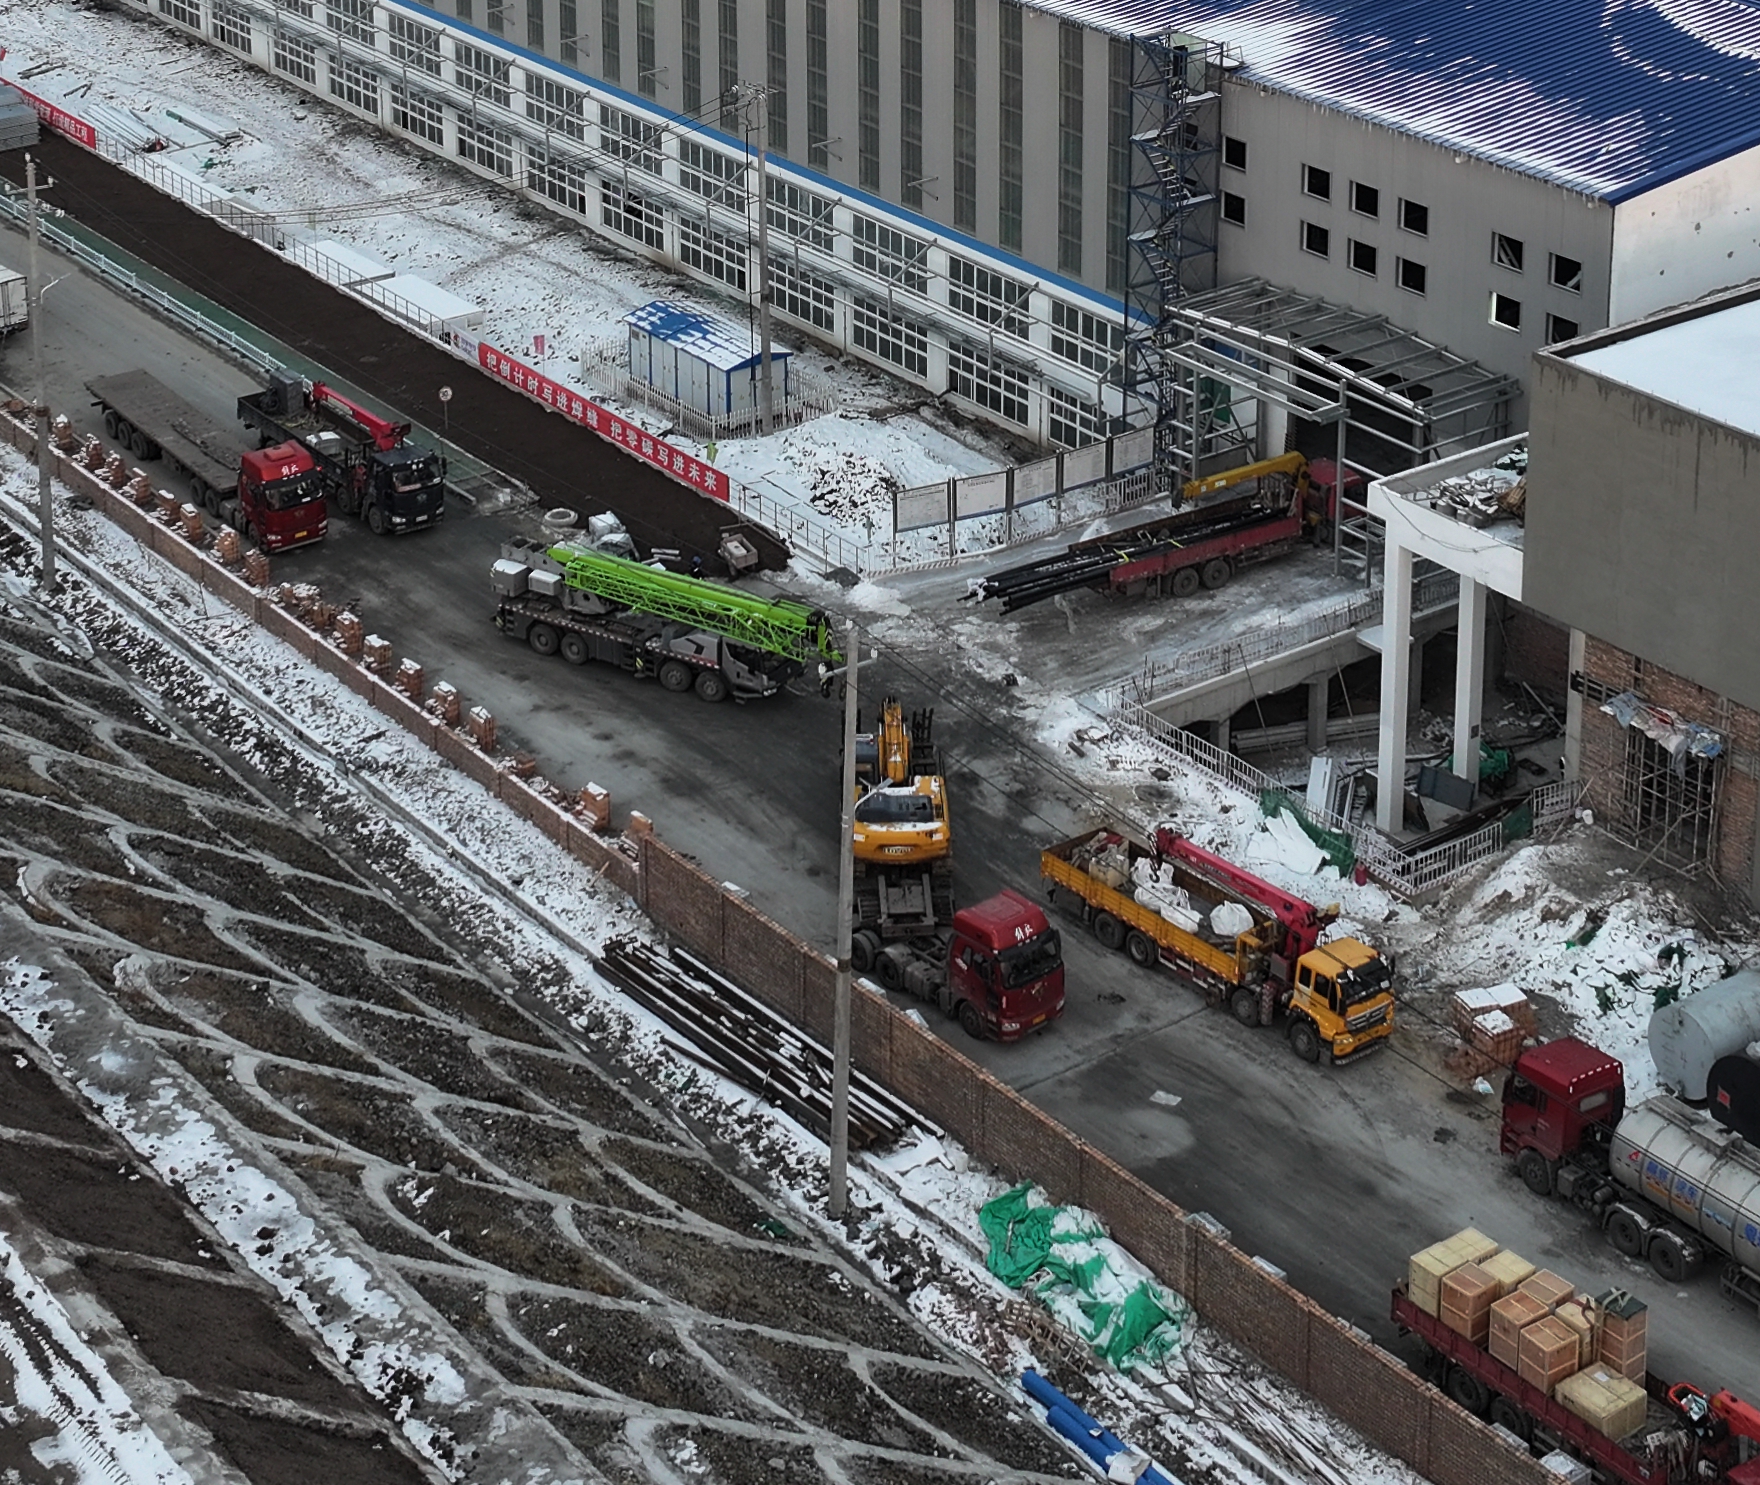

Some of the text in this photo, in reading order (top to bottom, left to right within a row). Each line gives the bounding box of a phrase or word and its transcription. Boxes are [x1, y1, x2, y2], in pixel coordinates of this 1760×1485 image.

[486, 350, 718, 493] 把倒计时写进焊缝 把零碳写进未来
